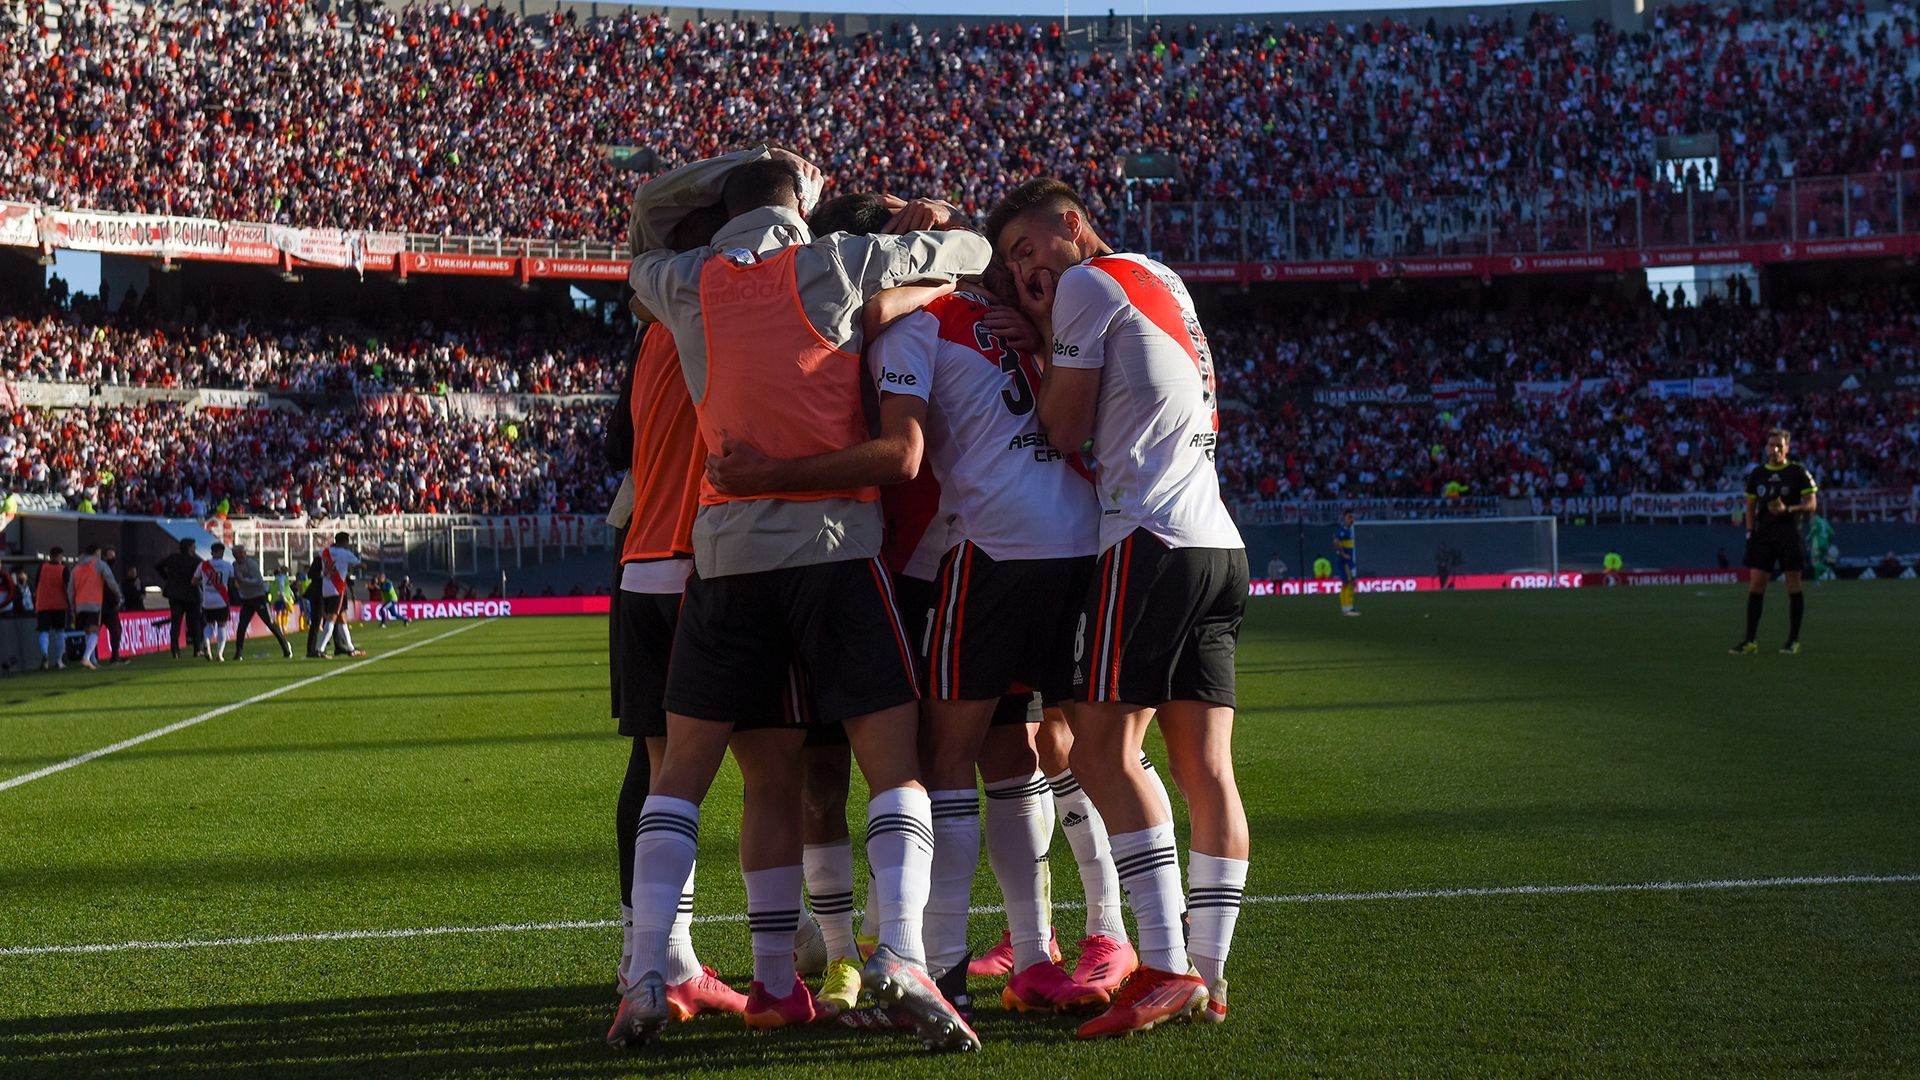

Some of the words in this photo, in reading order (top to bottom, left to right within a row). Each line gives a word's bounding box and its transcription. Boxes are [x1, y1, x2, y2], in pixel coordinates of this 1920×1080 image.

[68, 218, 91, 243] LOS
[96, 221, 132, 245] RIBES
[136, 221, 154, 245] DE
[236, 247, 272, 258] AIRLINES
[433, 257, 470, 268] TURKISH
[471, 259, 509, 271] AIRLINES
[552, 262, 589, 273] TURKISH
[590, 263, 628, 275] AIRLINES
[1626, 575, 1681, 587] TURKISH
[1683, 572, 1738, 585] AIRLINES
[411, 600, 511, 619] TRANSFOR
[1073, 611, 1087, 663] 8
